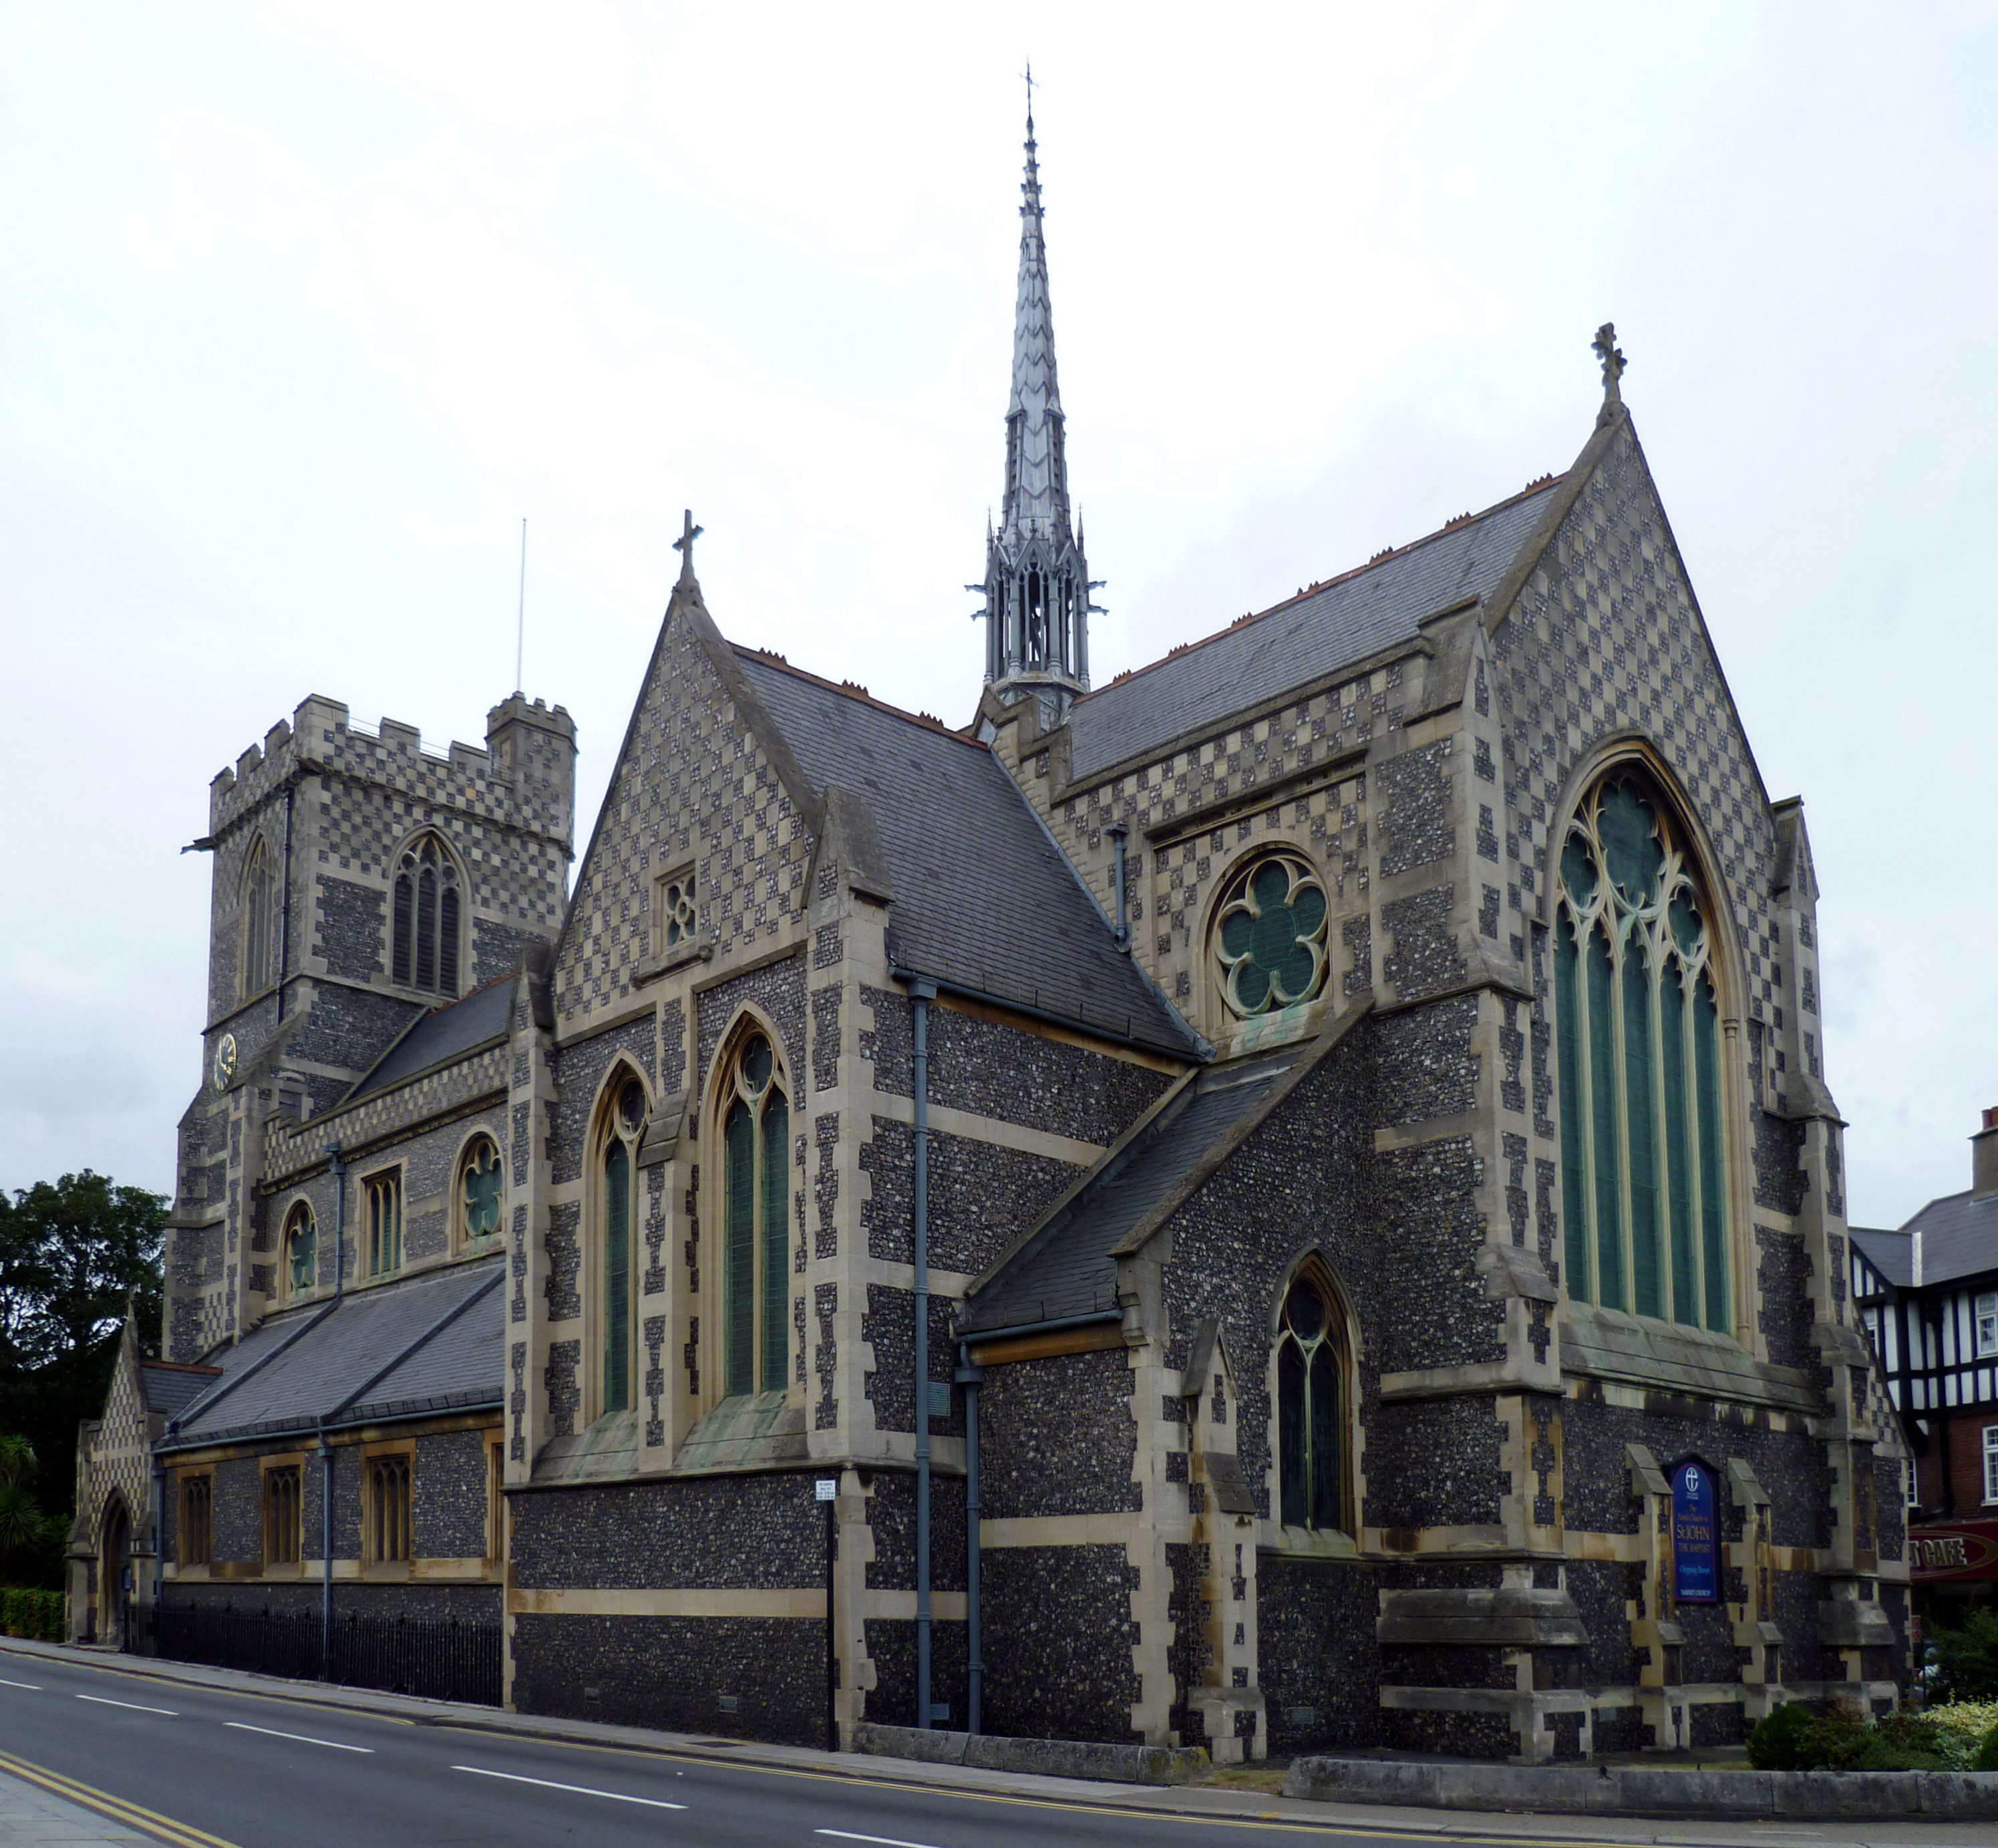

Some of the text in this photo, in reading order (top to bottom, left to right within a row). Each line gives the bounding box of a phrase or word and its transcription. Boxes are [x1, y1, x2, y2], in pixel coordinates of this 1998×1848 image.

[1678, 1543, 1711, 1553] THE BAPTIST
[1920, 1538, 1968, 1567] CAFE
